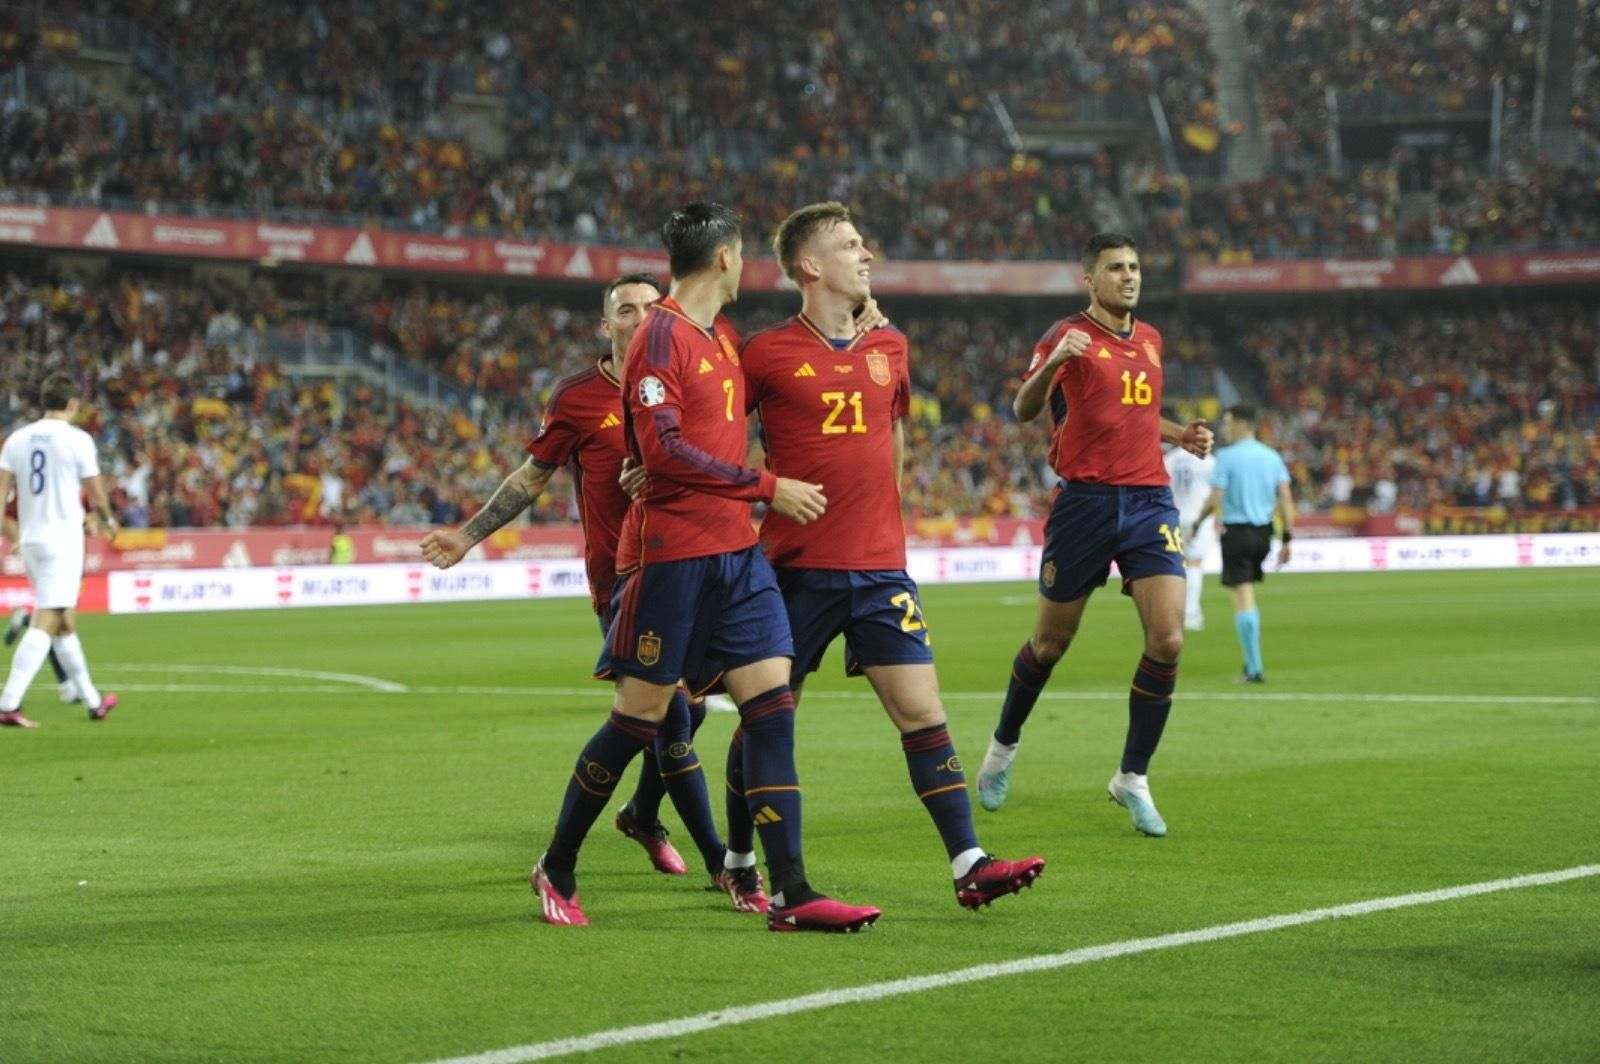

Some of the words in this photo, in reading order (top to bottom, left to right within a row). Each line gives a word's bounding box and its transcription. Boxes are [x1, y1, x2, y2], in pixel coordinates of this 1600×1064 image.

[722, 378, 735, 422] 7
[1120, 370, 1152, 405] 16
[820, 391, 868, 435] 21
[30, 450, 46, 495] 8
